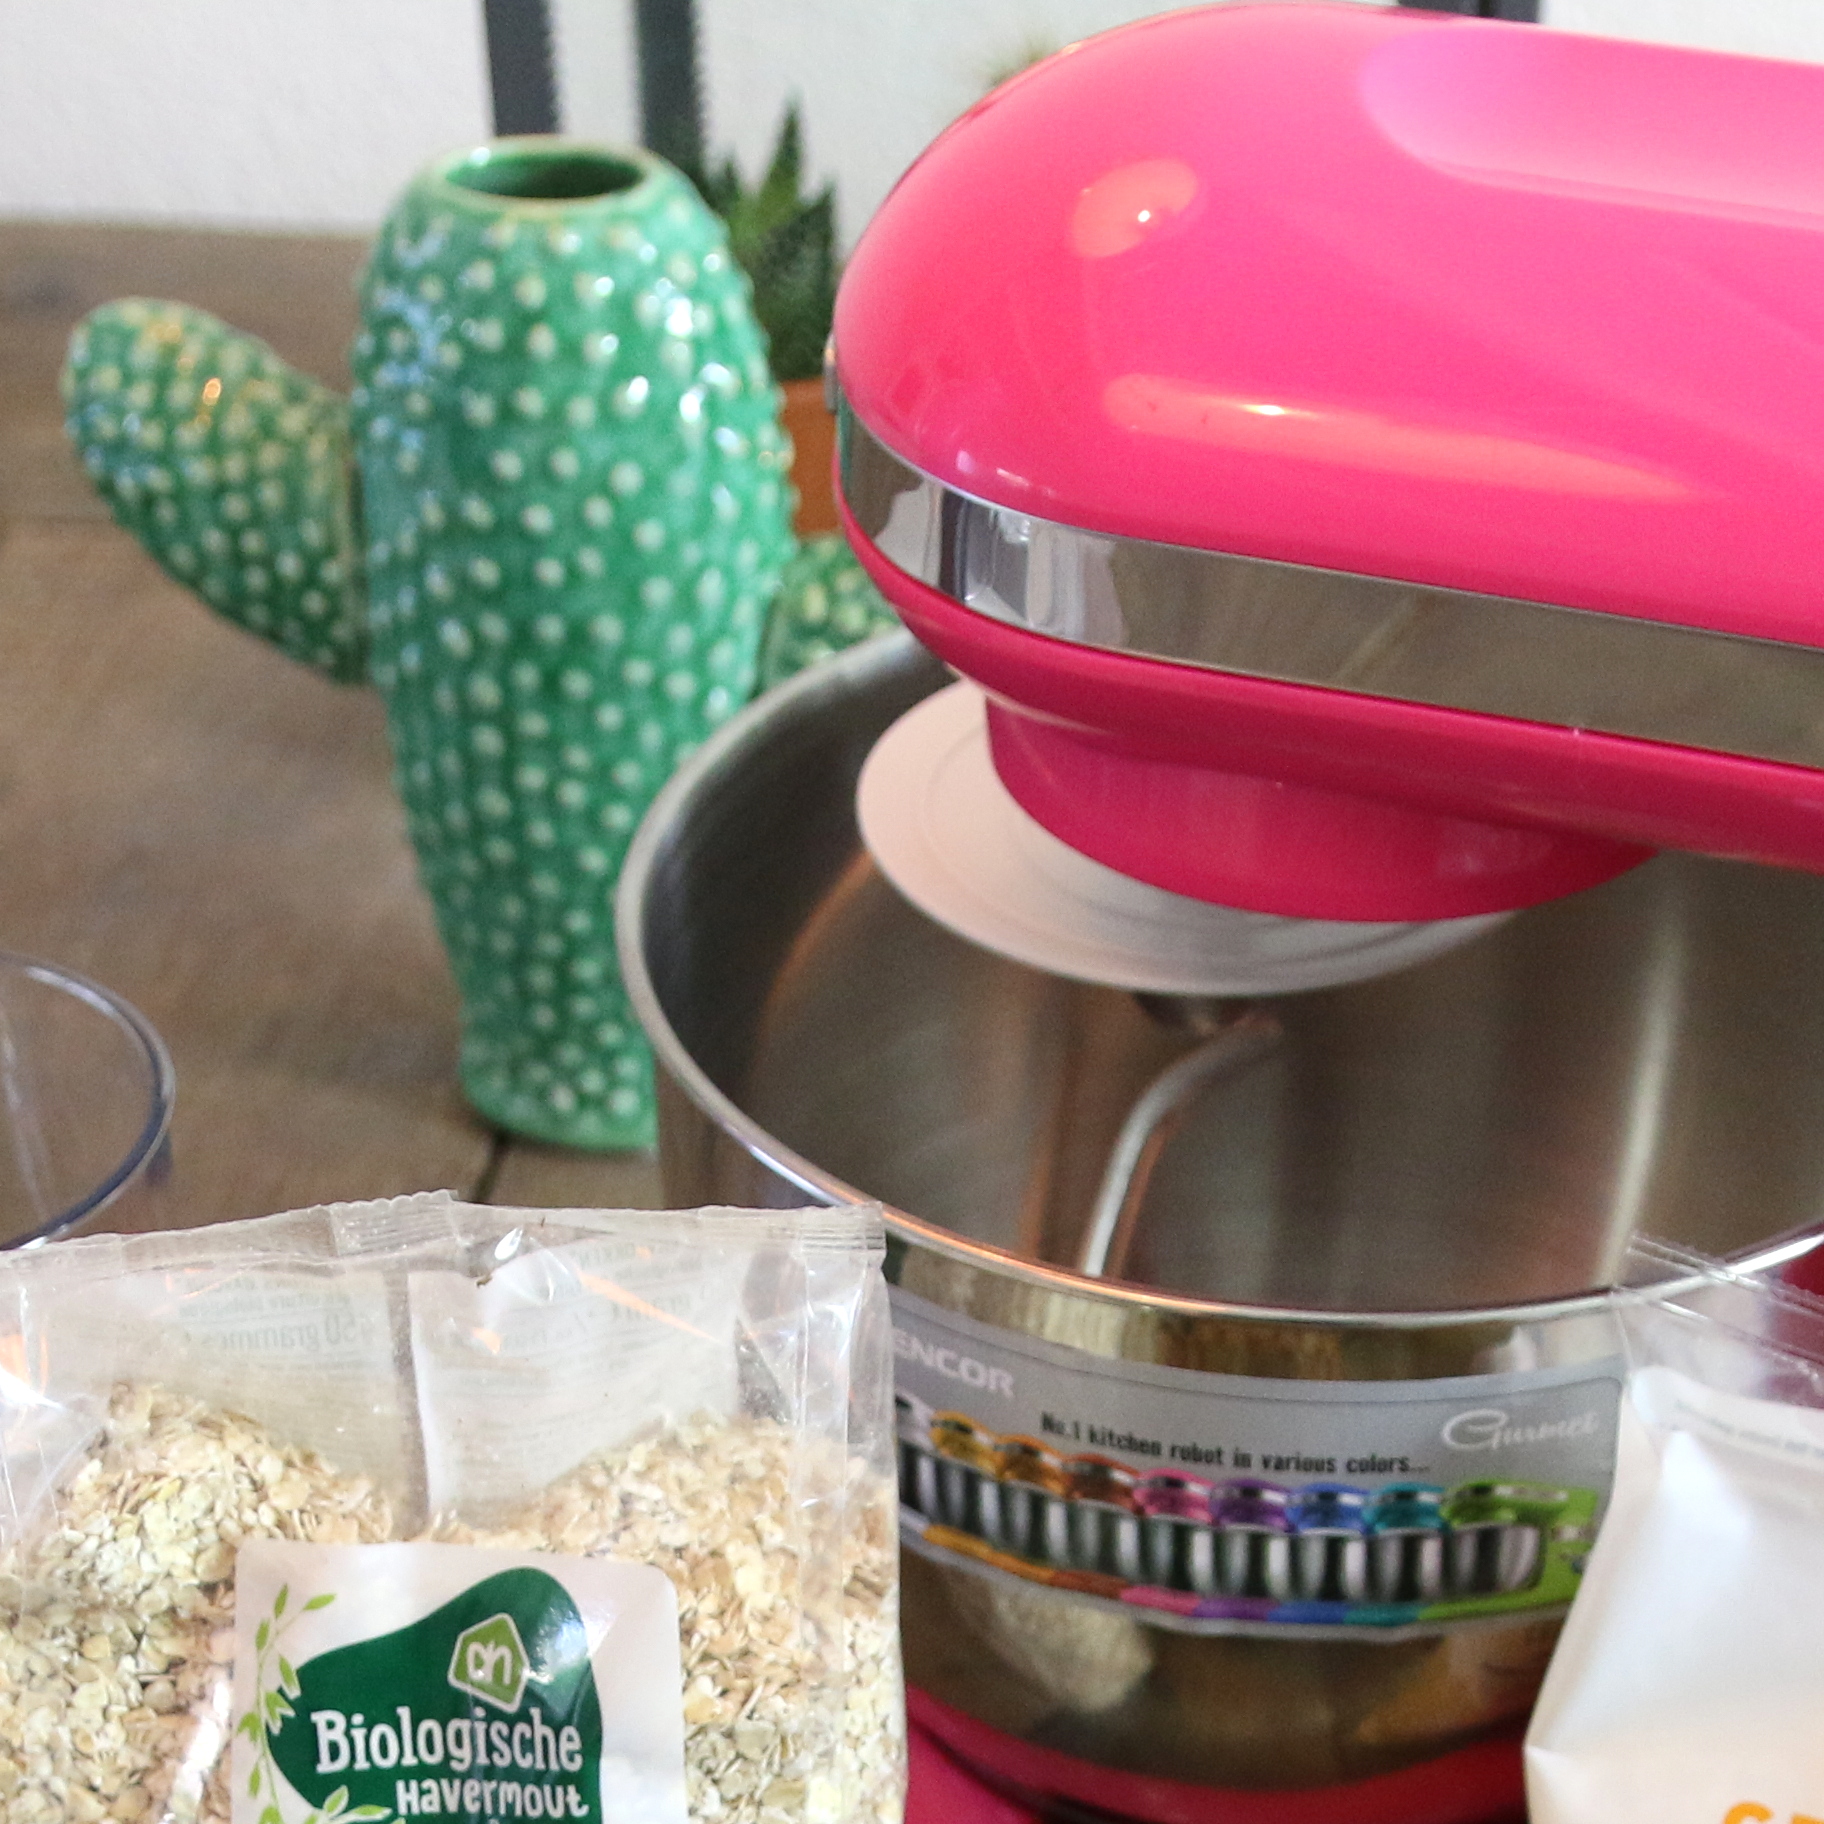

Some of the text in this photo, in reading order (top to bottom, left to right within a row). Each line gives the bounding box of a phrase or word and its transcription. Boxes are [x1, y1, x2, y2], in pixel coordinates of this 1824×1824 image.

[893, 1328, 1015, 1399] ENCOR
[1041, 1410, 1080, 1441] No.1
[1089, 1424, 1163, 1457] kitchen
[1170, 1439, 1223, 1467] robot
[1232, 1446, 1252, 1469] in
[1261, 1450, 1336, 1474] various
[310, 1705, 583, 1775] Biologische
